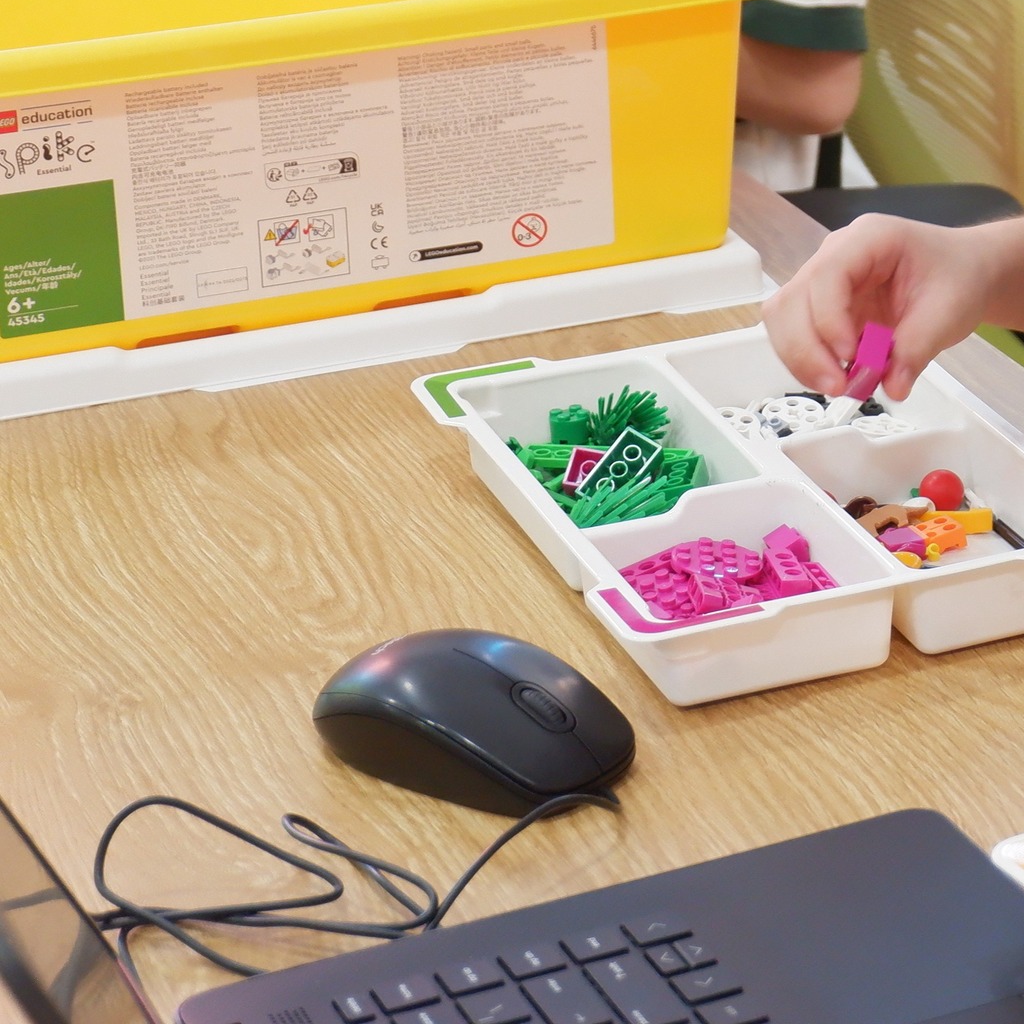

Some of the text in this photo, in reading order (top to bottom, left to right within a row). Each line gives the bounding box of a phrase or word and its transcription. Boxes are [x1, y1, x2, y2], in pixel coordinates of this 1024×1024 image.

[0, 107, 93, 126] EGO education
[37, 164, 72, 176] Essential
[370, 236, 388, 249] CE
[7, 297, 36, 314] 6+
[8, 313, 45, 327] 45345
